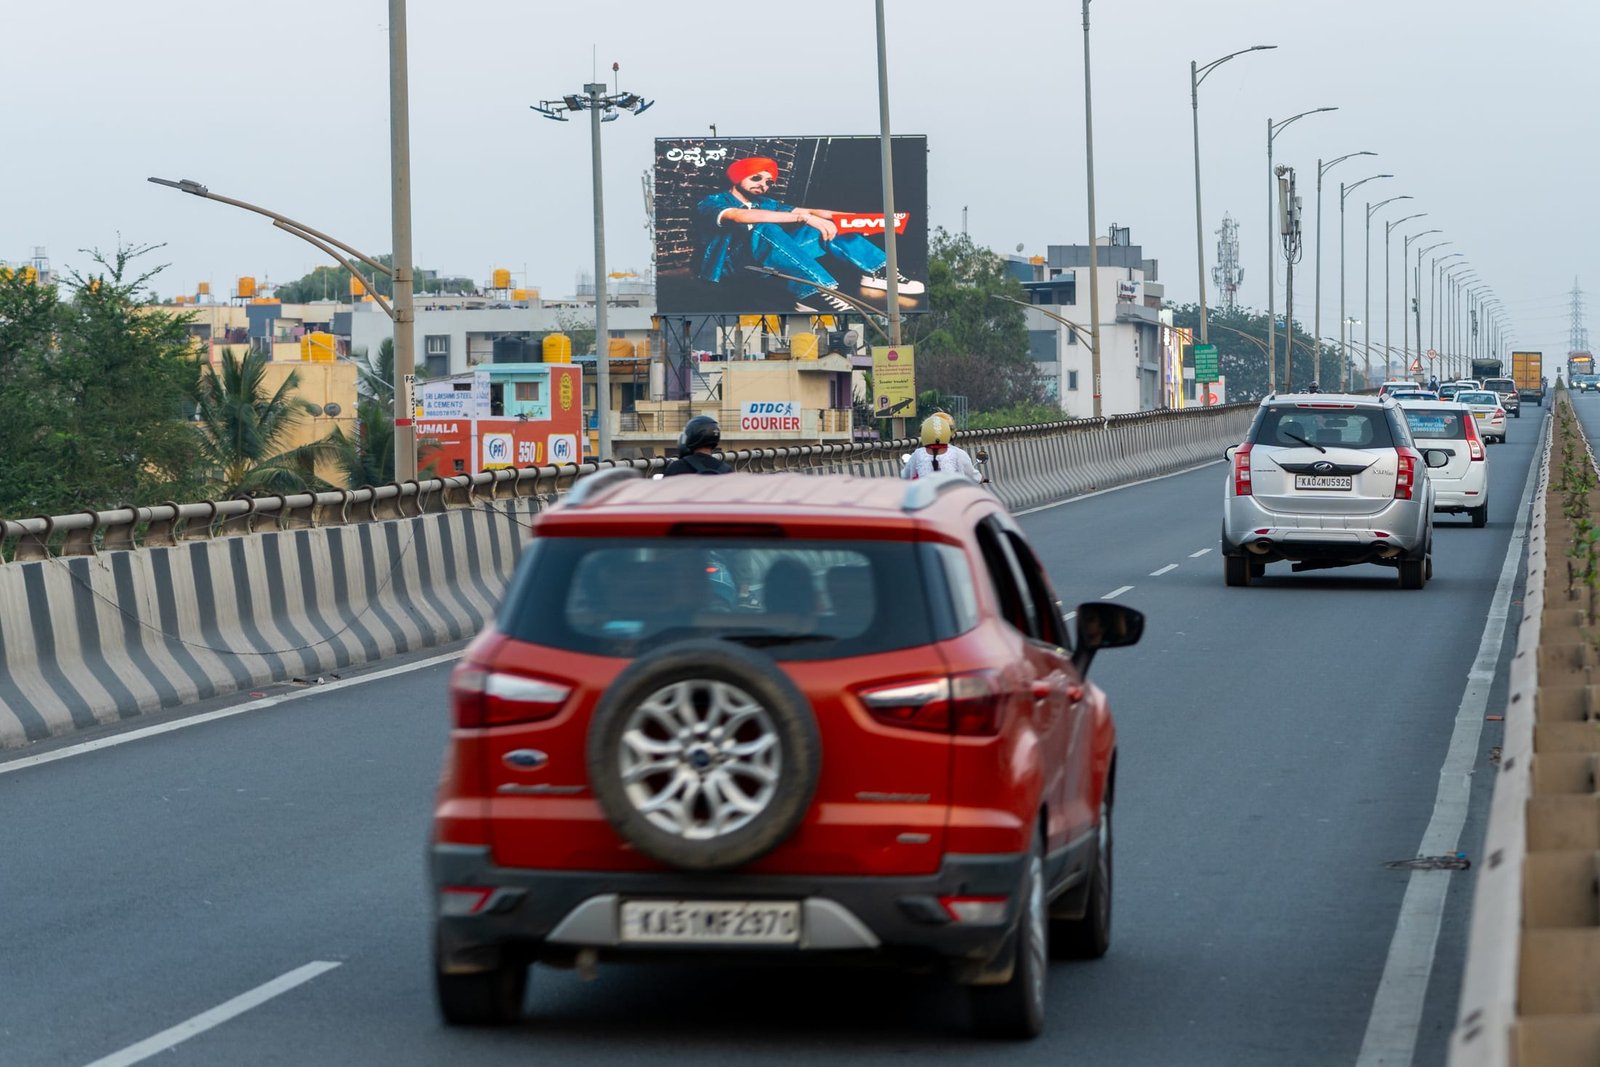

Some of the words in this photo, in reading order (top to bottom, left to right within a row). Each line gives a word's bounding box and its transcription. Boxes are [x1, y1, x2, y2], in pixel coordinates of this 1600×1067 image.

[433, 400, 464, 408] CEMENTS
[749, 402, 784, 414] DTDC
[741, 416, 801, 431] COURIER
[1301, 477, 1351, 488] KA04MU5926
